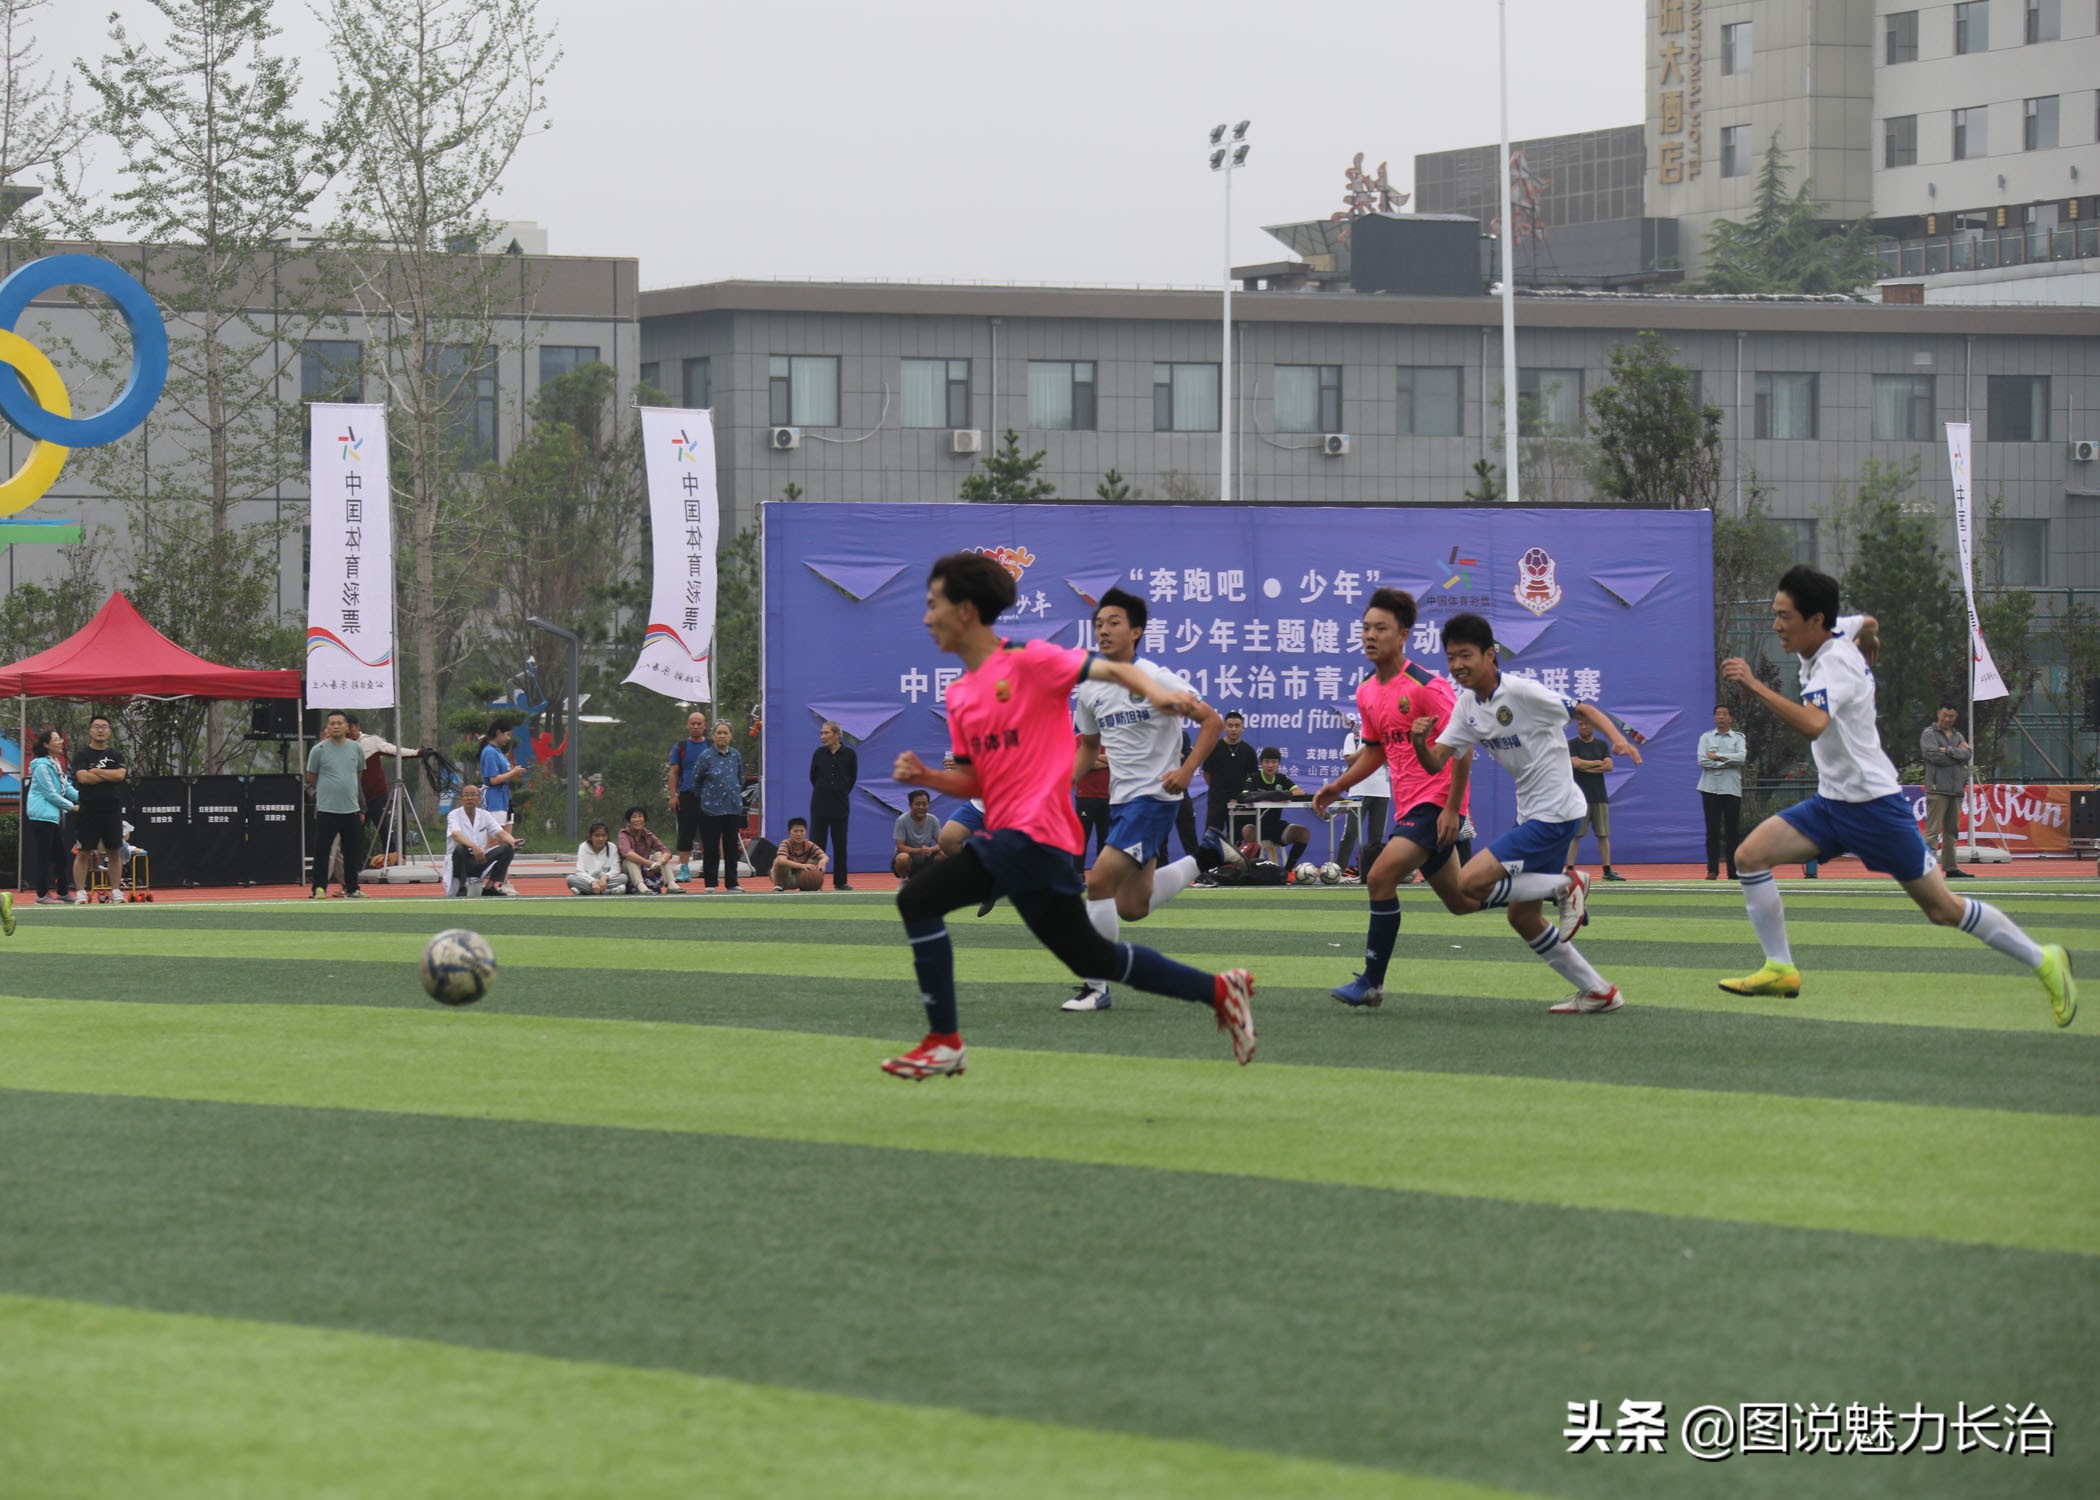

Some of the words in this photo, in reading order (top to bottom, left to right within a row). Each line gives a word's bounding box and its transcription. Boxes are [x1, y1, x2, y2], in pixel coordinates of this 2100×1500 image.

[1427, 594, 1490, 608] 中国体育彩票
[1994, 783, 2065, 829] Run
